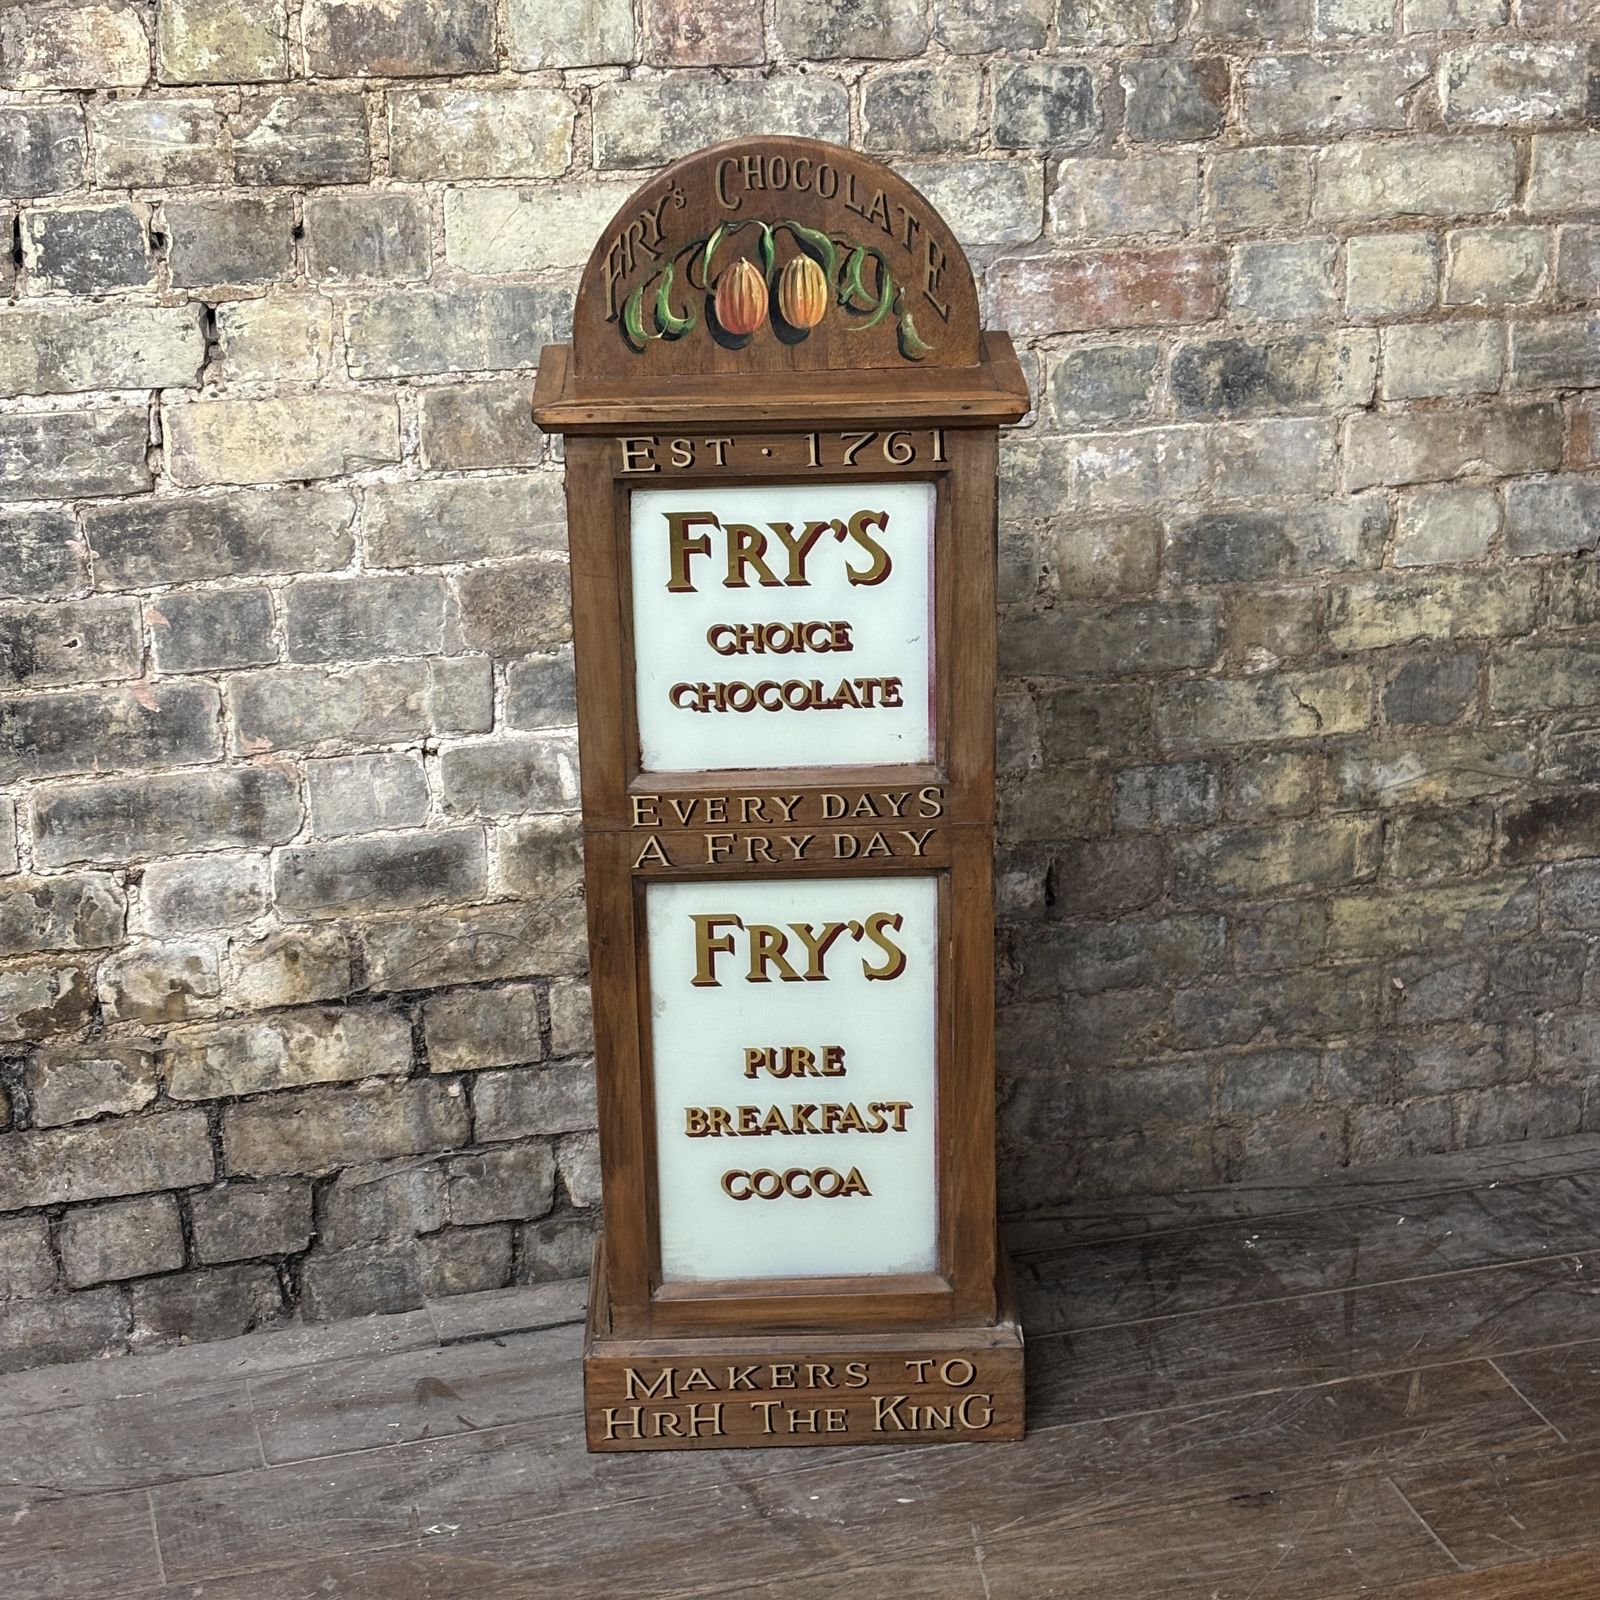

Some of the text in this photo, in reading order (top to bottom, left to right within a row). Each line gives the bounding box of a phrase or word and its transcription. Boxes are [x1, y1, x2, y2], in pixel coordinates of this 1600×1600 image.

[714, 154, 951, 324] CHOCOLATE
[616, 427, 949, 474] EST 1761
[661, 508, 893, 593] FRY'S
[706, 620, 854, 655] CHOICE
[668, 676, 904, 713] CHOCOLATE
[631, 786, 945, 828] EVERY DAYS
[631, 828, 937, 869] A FRY DAY
[688, 911, 908, 987] FRY'S
[743, 1045, 847, 1079] PURE
[684, 1100, 914, 1138] BREAKFAST
[720, 1166, 873, 1201] COCOA
[623, 1358, 978, 1400] MAKERS TO
[750, 1400, 849, 1435] THE
[871, 1393, 996, 1433] KING
